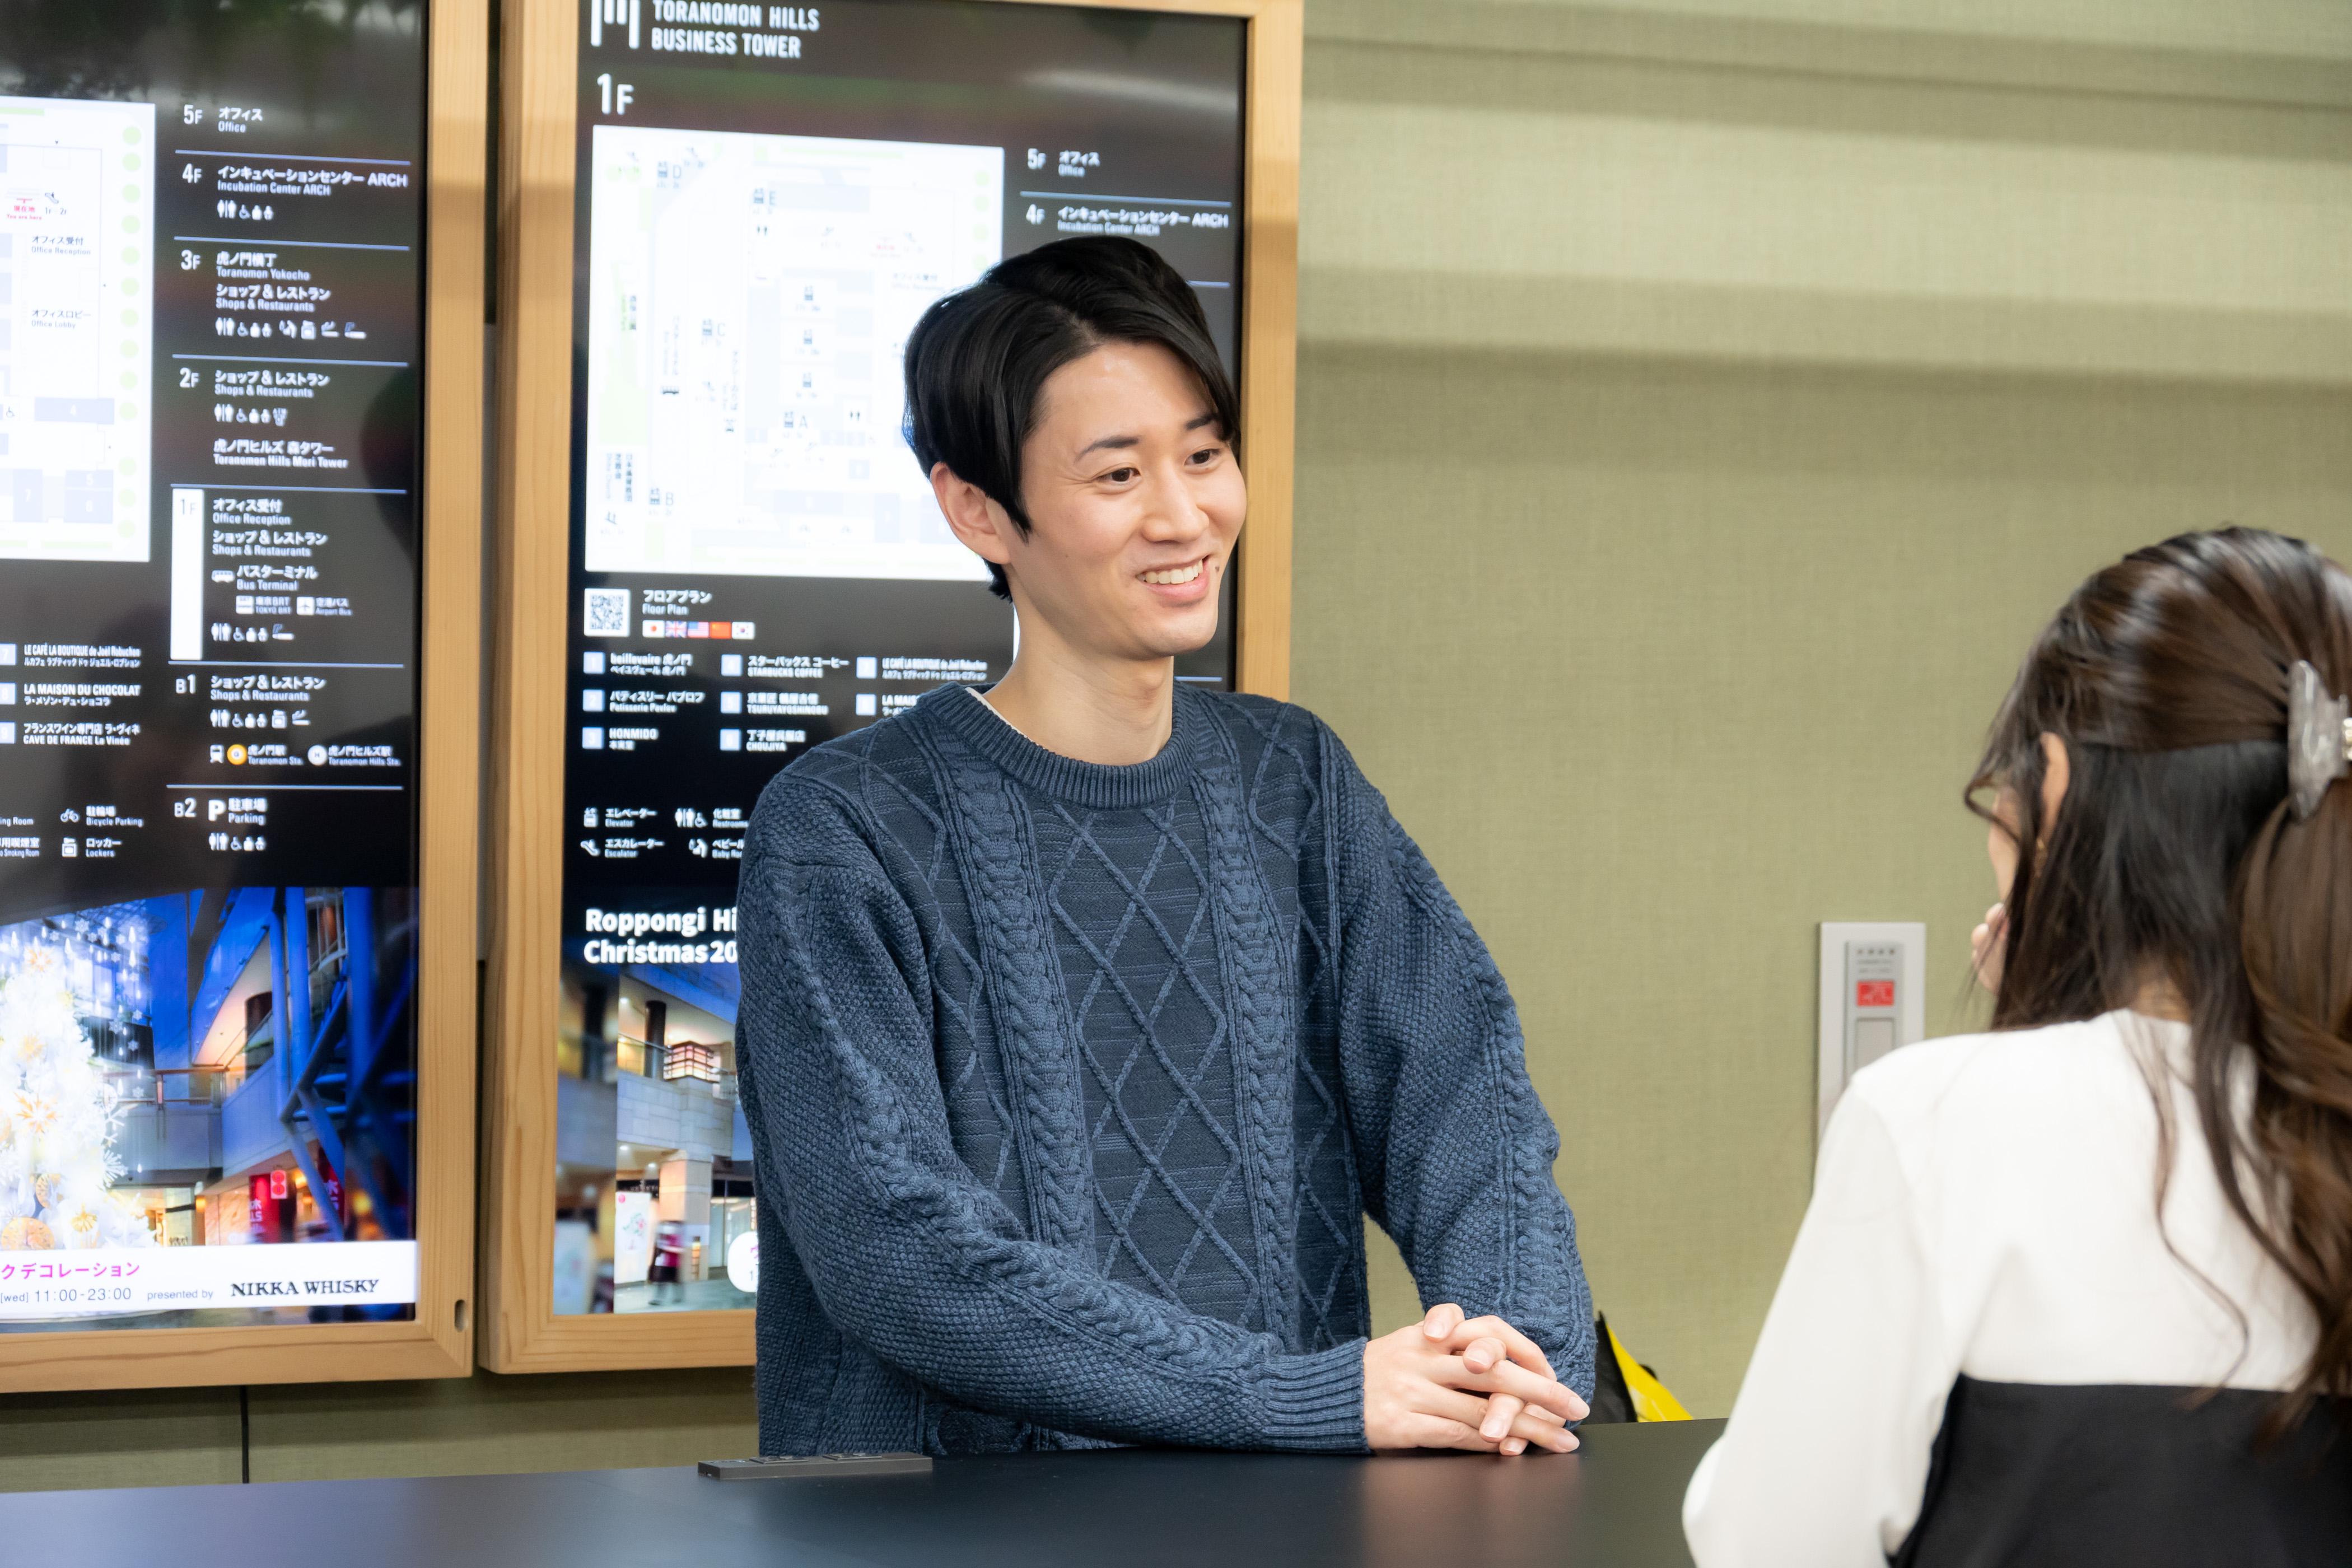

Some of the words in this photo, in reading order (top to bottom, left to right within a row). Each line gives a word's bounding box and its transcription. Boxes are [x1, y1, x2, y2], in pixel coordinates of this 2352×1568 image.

[652, 0, 762, 27] TORANOMON
[769, 6, 819, 31] HILLS
[652, 27, 737, 55] BUSINESS
[742, 32, 801, 58] TOWER
[598, 73, 634, 115] 1F
[184, 104, 203, 124] 5F
[219, 107, 263, 121] オフィス
[218, 122, 246, 133] Office
[1027, 148, 1046, 169] 5F
[1060, 150, 1100, 167] オフィス
[183, 163, 202, 183] 4F
[217, 166, 365, 185] インキュベーションセンター
[367, 174, 408, 188] ARCH
[217, 180, 267, 193] Incubation
[270, 182, 301, 194] Center
[304, 185, 331, 196] ARCH
[1192, 213, 1229, 228] ARCH
[32, 236, 83, 245] オフィス受付
[181, 250, 200, 270] 3F
[217, 267, 268, 279] Toranomon
[270, 269, 310, 281] Yokocho
[217, 284, 260, 298] ショップ
[262, 284, 273, 299] &
[277, 287, 332, 301] レストラン
[216, 298, 245, 310] Shops
[247, 299, 255, 310] &
[258, 300, 315, 312] Restaurants
[32, 309, 91, 319] オフィスロビー
[717, 323, 726, 337] C
[180, 367, 199, 388] 2F
[215, 370, 260, 385] ショップ
[262, 371, 272, 385] &
[276, 372, 330, 386] レストラン
[214, 384, 244, 397] Shops
[246, 385, 254, 396] &
[256, 385, 314, 398] Restaurants
[214, 438, 284, 454] 虎ノ門ヒルズ
[213, 454, 265, 466] Toranomon
[268, 454, 290, 466] Hills
[292, 455, 316, 467] Mori
[318, 456, 349, 469] Tower
[180, 497, 198, 516] 1F
[213, 498, 282, 514] オフィス受付
[212, 512, 241, 524] Office
[243, 513, 292, 526] Reception
[213, 530, 257, 544] ショップ
[259, 530, 270, 545] &
[273, 531, 328, 545] レストラン
[212, 544, 241, 558] Shops
[244, 545, 252, 556] &
[254, 544, 312, 557] Restaurants
[237, 564, 319, 580] バスターミナル
[237, 579, 255, 591] Bus
[258, 580, 298, 591] Terminal
[643, 590, 712, 603] フロアプラン
[642, 603, 665, 614] Floor
[668, 604, 688, 615] Plan
[24, 645, 32, 655] LE
[32, 642, 48, 655] CAFÉ
[49, 645, 57, 655] LA
[57, 645, 88, 656] BOUTIQUE
[89, 646, 97, 656] de
[97, 646, 110, 656] Joël
[111, 646, 141, 657] Robuchon
[748, 656, 810, 668] スターバックス
[813, 657, 850, 669] コーヒー
[24, 684, 36, 694] LA
[38, 684, 76, 695] MAISON
[78, 684, 91, 695] DU
[92, 685, 141, 696] CHOCOLAT
[176, 674, 195, 694] B1
[211, 675, 255, 689] ショップ
[257, 675, 268, 689] &
[272, 676, 326, 690] レストラン
[211, 690, 239, 702] Shops
[242, 690, 250, 701] &
[252, 690, 310, 701] Restaurants
[610, 691, 664, 702] パティスリー
[667, 692, 704, 703] パブロフ
[24, 723, 102, 735] フランスワイン専門店
[609, 729, 658, 739] HONMIDO
[24, 735, 45, 744] CAVE
[47, 735, 58, 744] DE
[60, 735, 93, 745] FRANCE
[248, 756, 288, 765] Toranomon
[329, 757, 368, 765] Toranomon
[175, 797, 197, 817] B2
[208, 800, 226, 821] P
[605, 808, 657, 819] エレベーター
[86, 818, 113, 826] Bicycle
[115, 818, 143, 827] Parking
[228, 813, 265, 825] Parking
[86, 838, 122, 848] ロッカー
[605, 838, 665, 849] エスカレーター
[586, 907, 706, 937] Roppongi
[713, 907, 737, 931] Hi
[1, 1262, 140, 1280] クデコレーション
[35, 1287, 132, 1302] 11:00-23:00
[147, 1290, 198, 1301] presented
[202, 1289, 213, 1300] by
[231, 1280, 299, 1297] NIKKA
[304, 1278, 380, 1295] WHISKY
